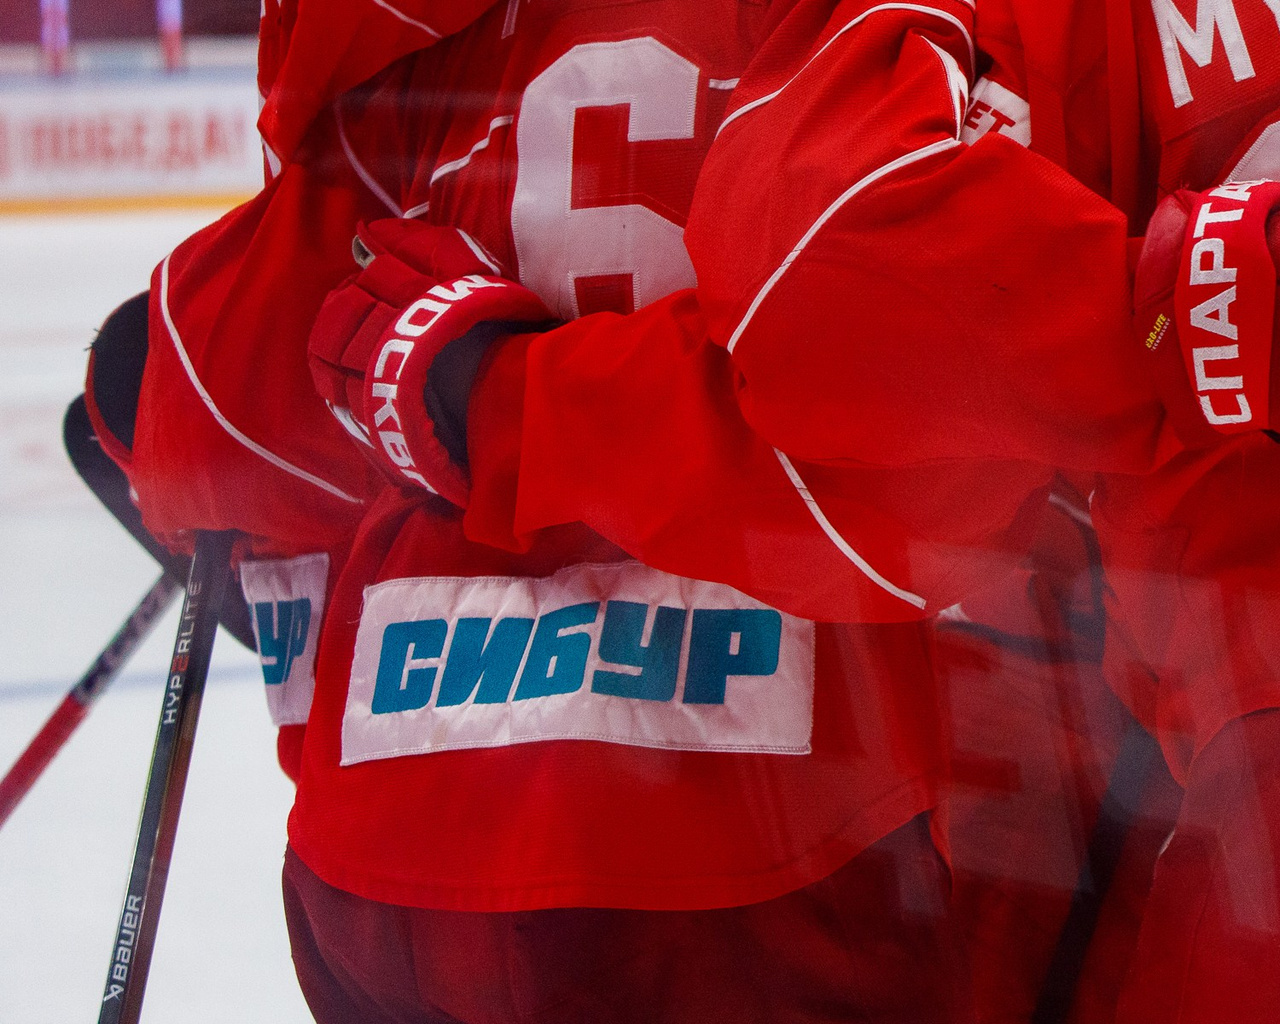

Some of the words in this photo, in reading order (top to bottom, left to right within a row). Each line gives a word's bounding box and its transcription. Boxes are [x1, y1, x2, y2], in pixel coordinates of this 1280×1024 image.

[511, 36, 702, 322] 6
[370, 599, 783, 716] СИБУР
[112, 894, 142, 983] BAUER
